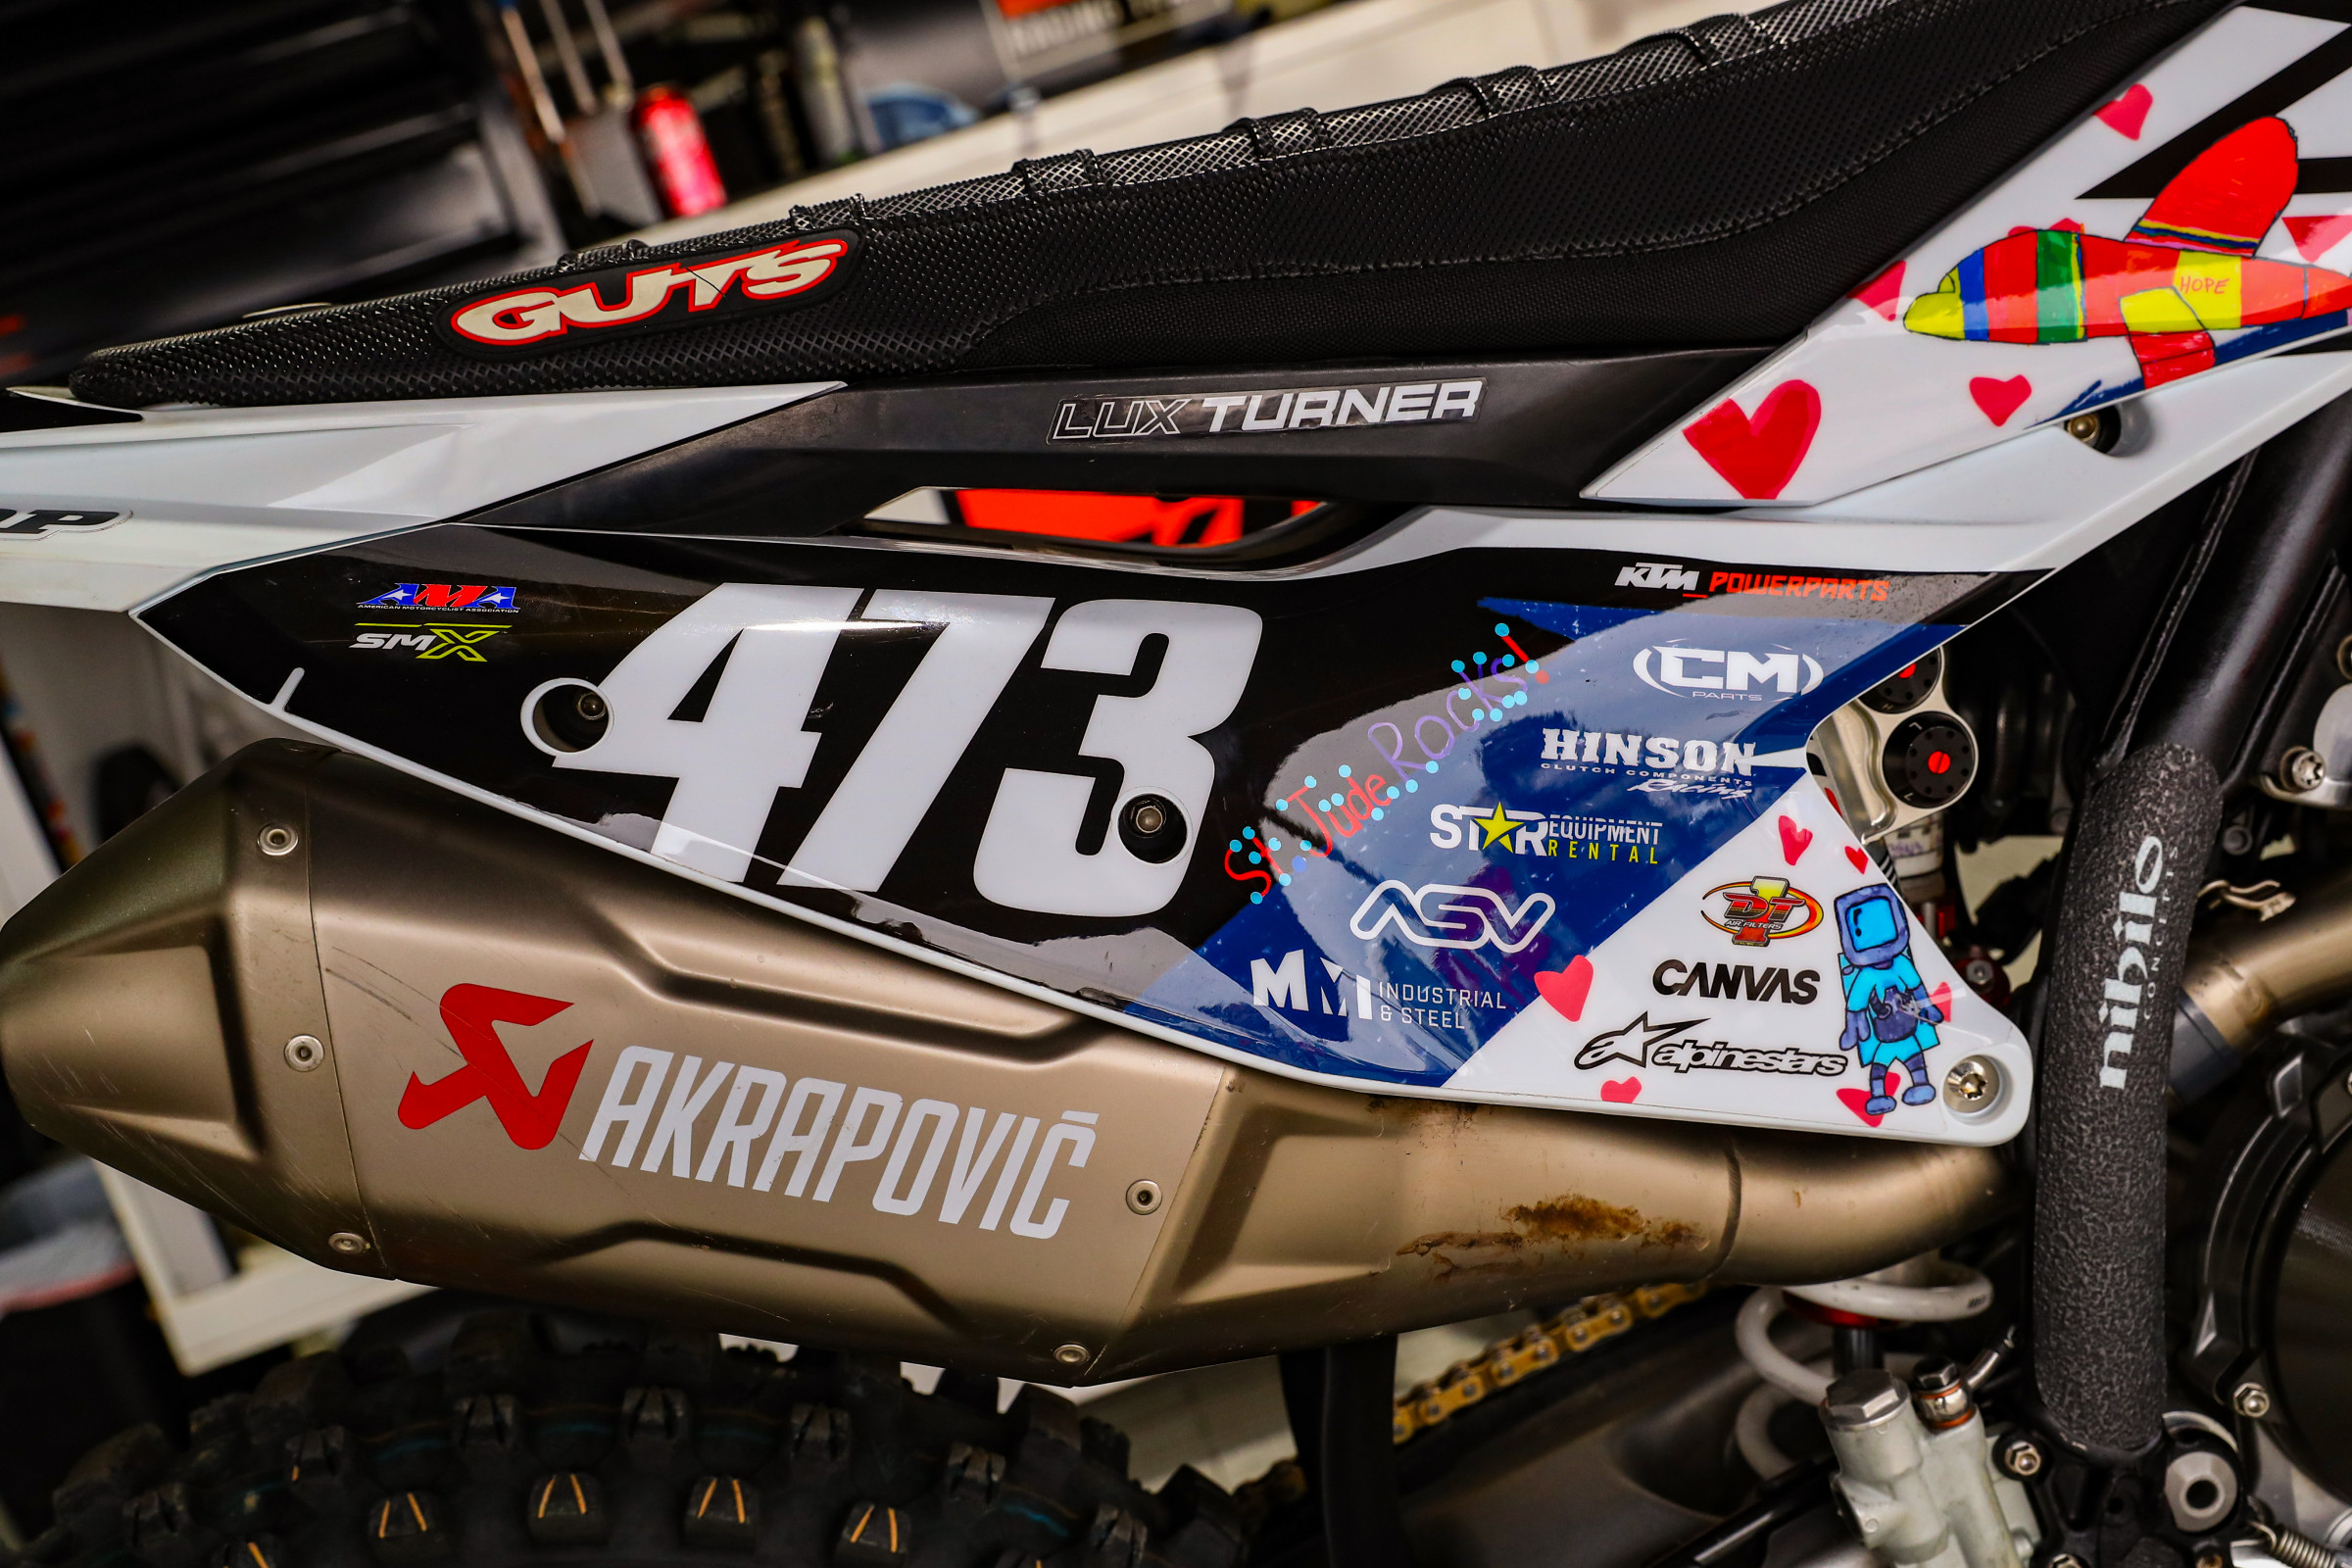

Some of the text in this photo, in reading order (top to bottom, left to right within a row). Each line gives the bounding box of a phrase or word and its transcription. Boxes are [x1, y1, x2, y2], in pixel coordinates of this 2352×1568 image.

[451, 239, 849, 346] GUTS
[2180, 275, 2230, 295] HOPE
[1053, 380, 1484, 440] LUX TURNER
[357, 582, 521, 610] AMA
[1614, 563, 1880, 602] KTM POWERPARTS
[348, 628, 501, 662] SMX
[1653, 646, 1799, 694] CM
[1692, 691, 1763, 703] PARTS
[551, 582, 1264, 918] 473
[1541, 727, 1757, 776] HINSON
[1541, 762, 1752, 787] CLUTCH COMPONENTS
[1276, 764, 1400, 858] Jude
[1548, 813, 1663, 846] EQUIPMENT
[1548, 840, 1658, 865] RENTAL
[1742, 921, 1784, 930] FILTERS
[2098, 835, 2164, 1090] nihilo
[1379, 982, 1507, 1009] INDUSTRIAL
[1652, 959, 1821, 1005] CANVAS
[1380, 1004, 1466, 1030] & STEEL
[1651, 1040, 1849, 1076] alpinestars
